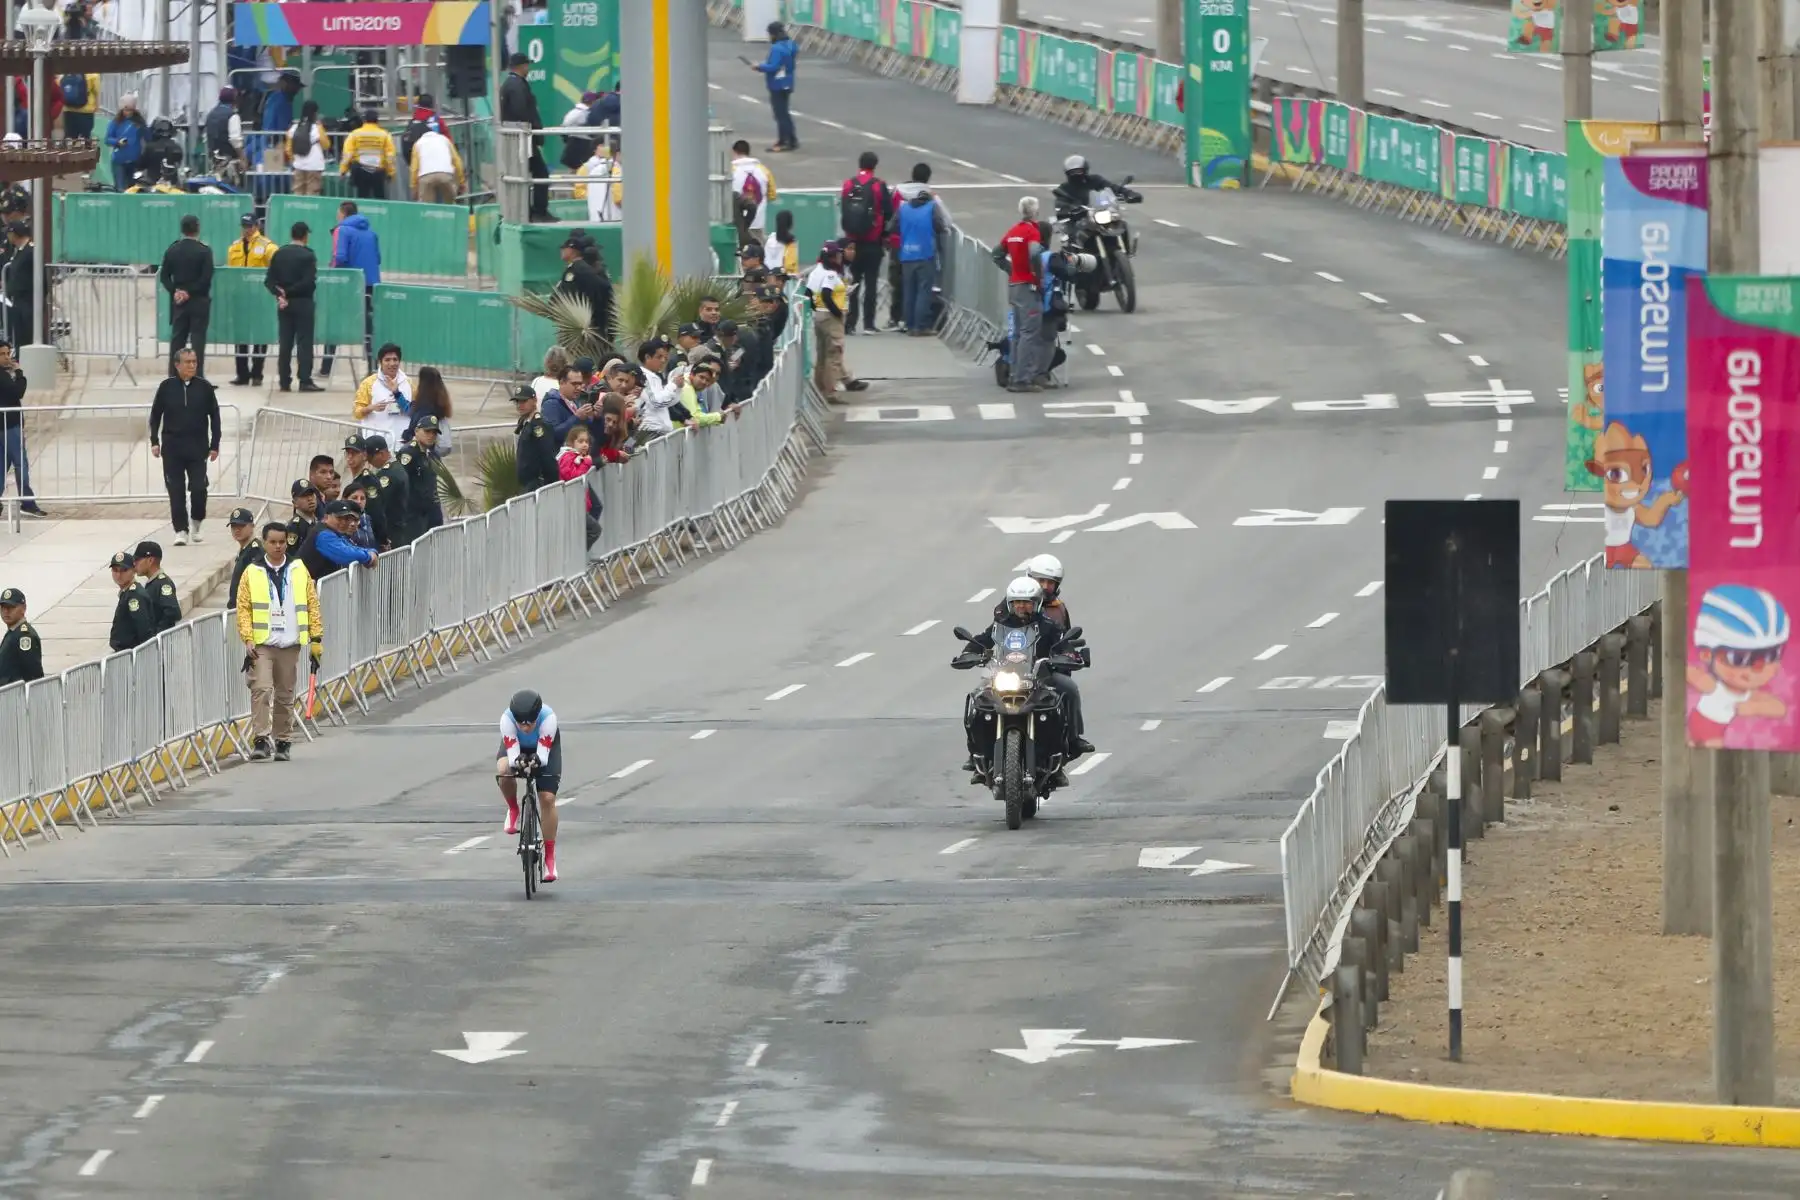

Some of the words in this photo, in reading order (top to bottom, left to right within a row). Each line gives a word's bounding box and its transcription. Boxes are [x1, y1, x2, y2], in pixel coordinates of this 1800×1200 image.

[562, 14, 598, 27] 2019
[528, 38, 544, 63] 0
[1213, 28, 1231, 53] 0
[1648, 179, 1698, 190] SPORTS
[845, 388, 1567, 422] SPACIO
[987, 504, 1604, 534] CRVA
